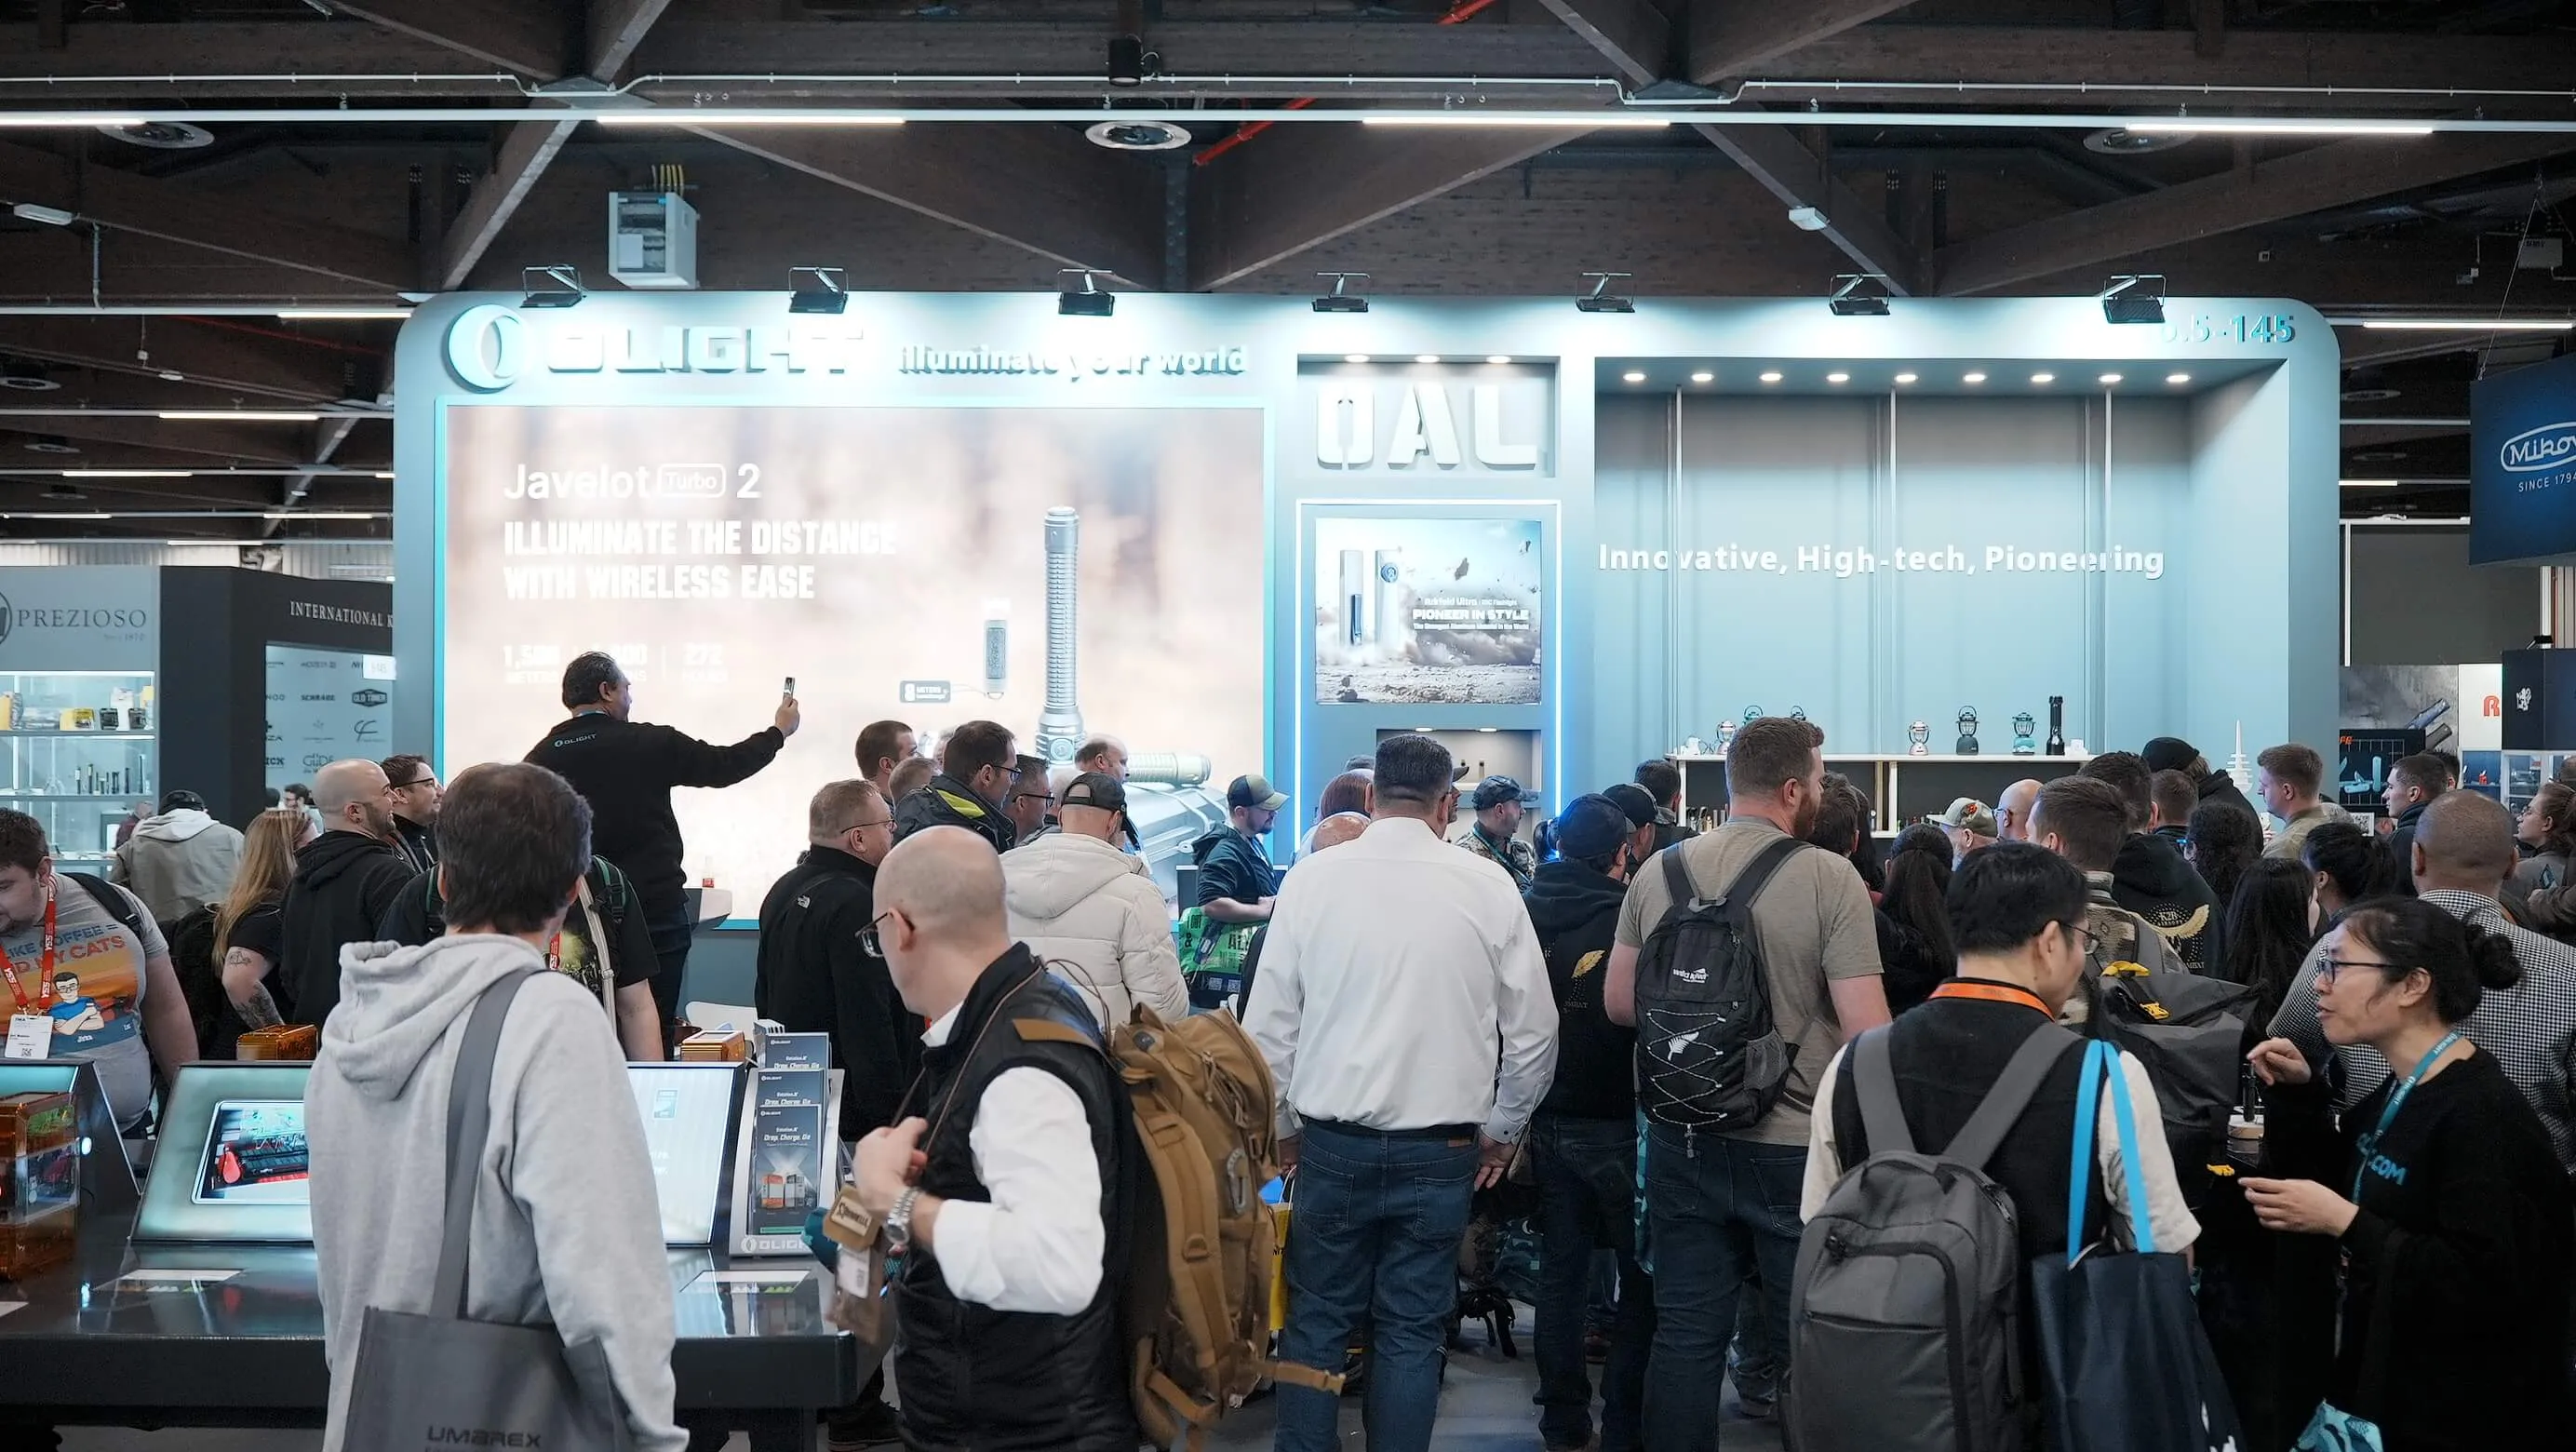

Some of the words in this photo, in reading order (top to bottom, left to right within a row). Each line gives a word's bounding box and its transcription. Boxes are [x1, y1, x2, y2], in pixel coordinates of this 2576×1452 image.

[546, 323, 865, 375] OLIGHT
[1068, 350, 1154, 383] your
[1157, 344, 1249, 375] world
[1316, 382, 1537, 471] OAL
[503, 464, 651, 500] Javelot
[663, 469, 718, 491] Turbo
[735, 463, 762, 500] 2
[2518, 477, 2550, 493] SINCE
[503, 519, 678, 557] ILLUMINATE
[686, 519, 742, 556] THE
[750, 518, 896, 556] DISTANCE
[1598, 544, 1789, 576] Innovative,
[1796, 544, 1978, 578] High-tech,
[1985, 544, 2166, 581] Pioneering
[503, 564, 577, 600] WITH
[585, 564, 732, 600] WIRELESS
[741, 564, 816, 600] EASE
[17, 609, 147, 627] PREZIOSO
[289, 600, 383, 627] INTERNATIONAL
[1412, 609, 1469, 620] PIONEER
[1471, 609, 1485, 620] IN
[1487, 609, 1530, 621] STYLE
[564, 733, 597, 745] OLIGHT
[69, 935, 127, 960] CATS
